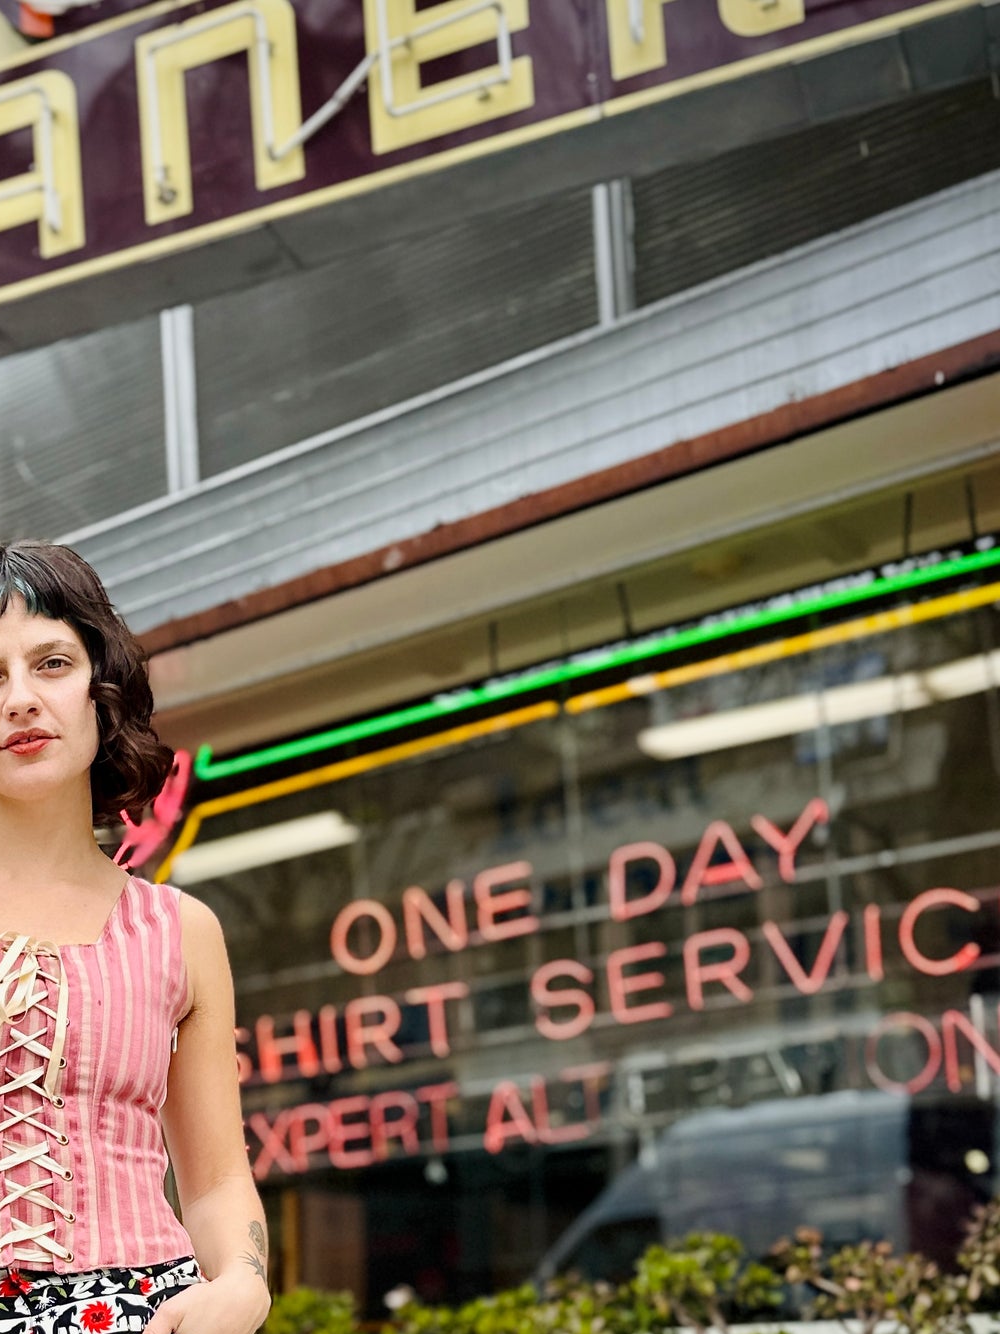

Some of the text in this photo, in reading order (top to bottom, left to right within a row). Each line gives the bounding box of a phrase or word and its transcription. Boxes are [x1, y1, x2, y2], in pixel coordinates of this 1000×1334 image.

[331, 799, 830, 976] ONE DAY
[531, 887, 1000, 1040] SERVIC
[242, 1081, 460, 1181] XPERT
